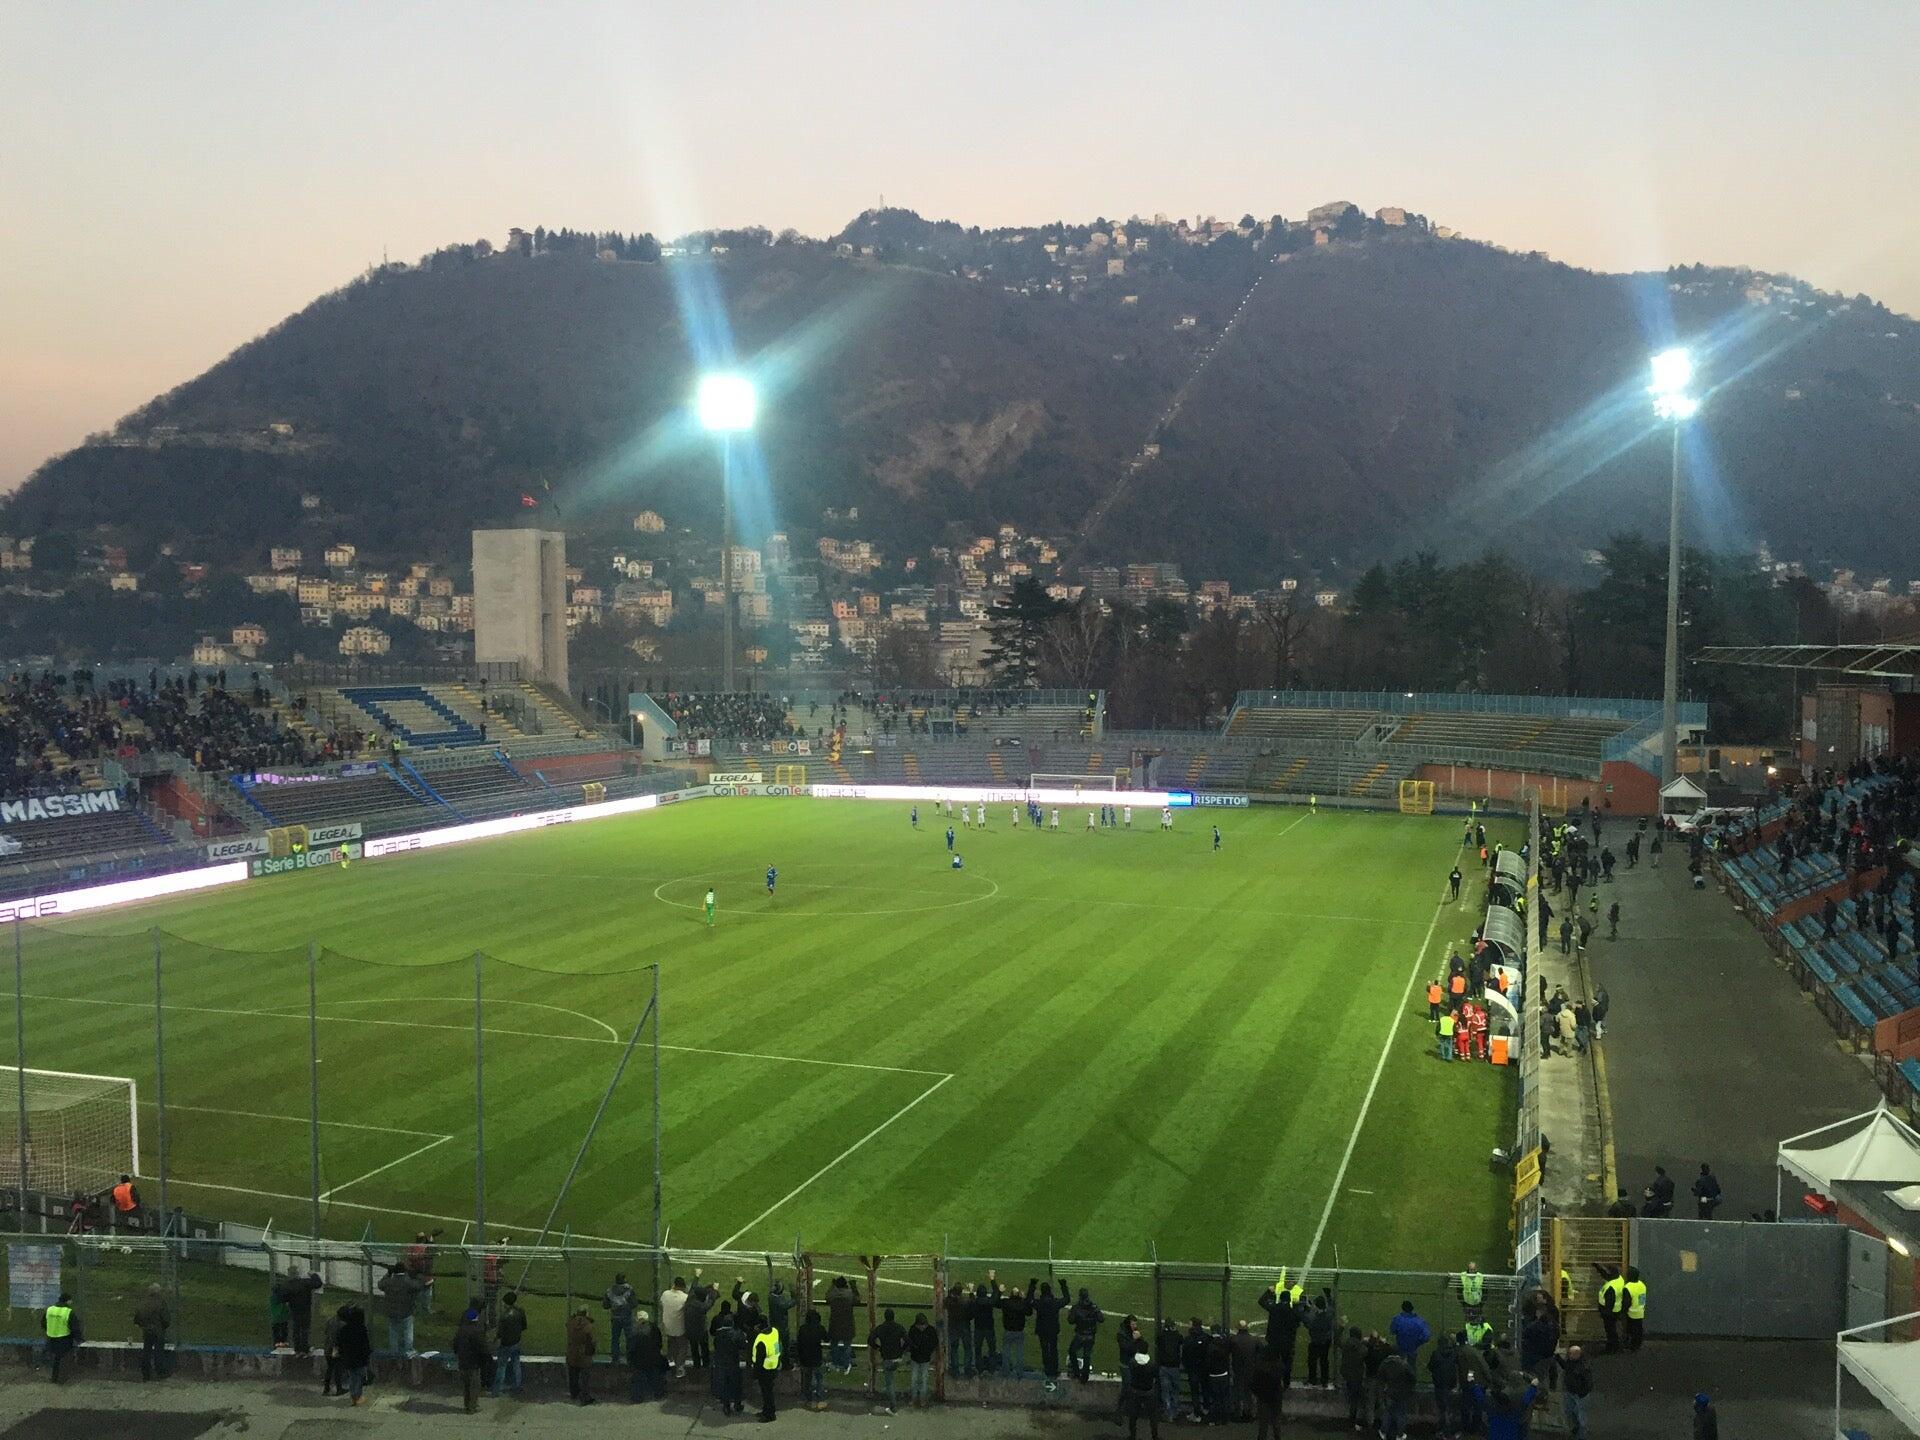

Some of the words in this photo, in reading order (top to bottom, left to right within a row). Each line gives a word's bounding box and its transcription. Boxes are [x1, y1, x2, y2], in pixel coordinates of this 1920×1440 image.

[714, 774, 748, 782] LEGEA
[0, 790, 119, 823] MASSIMI
[1195, 796, 1241, 805] RISPETTO
[313, 828, 348, 842] LEGEA
[213, 842, 252, 857] LEGEA
[264, 858, 294, 874] Serie
[296, 856, 306, 868] B
